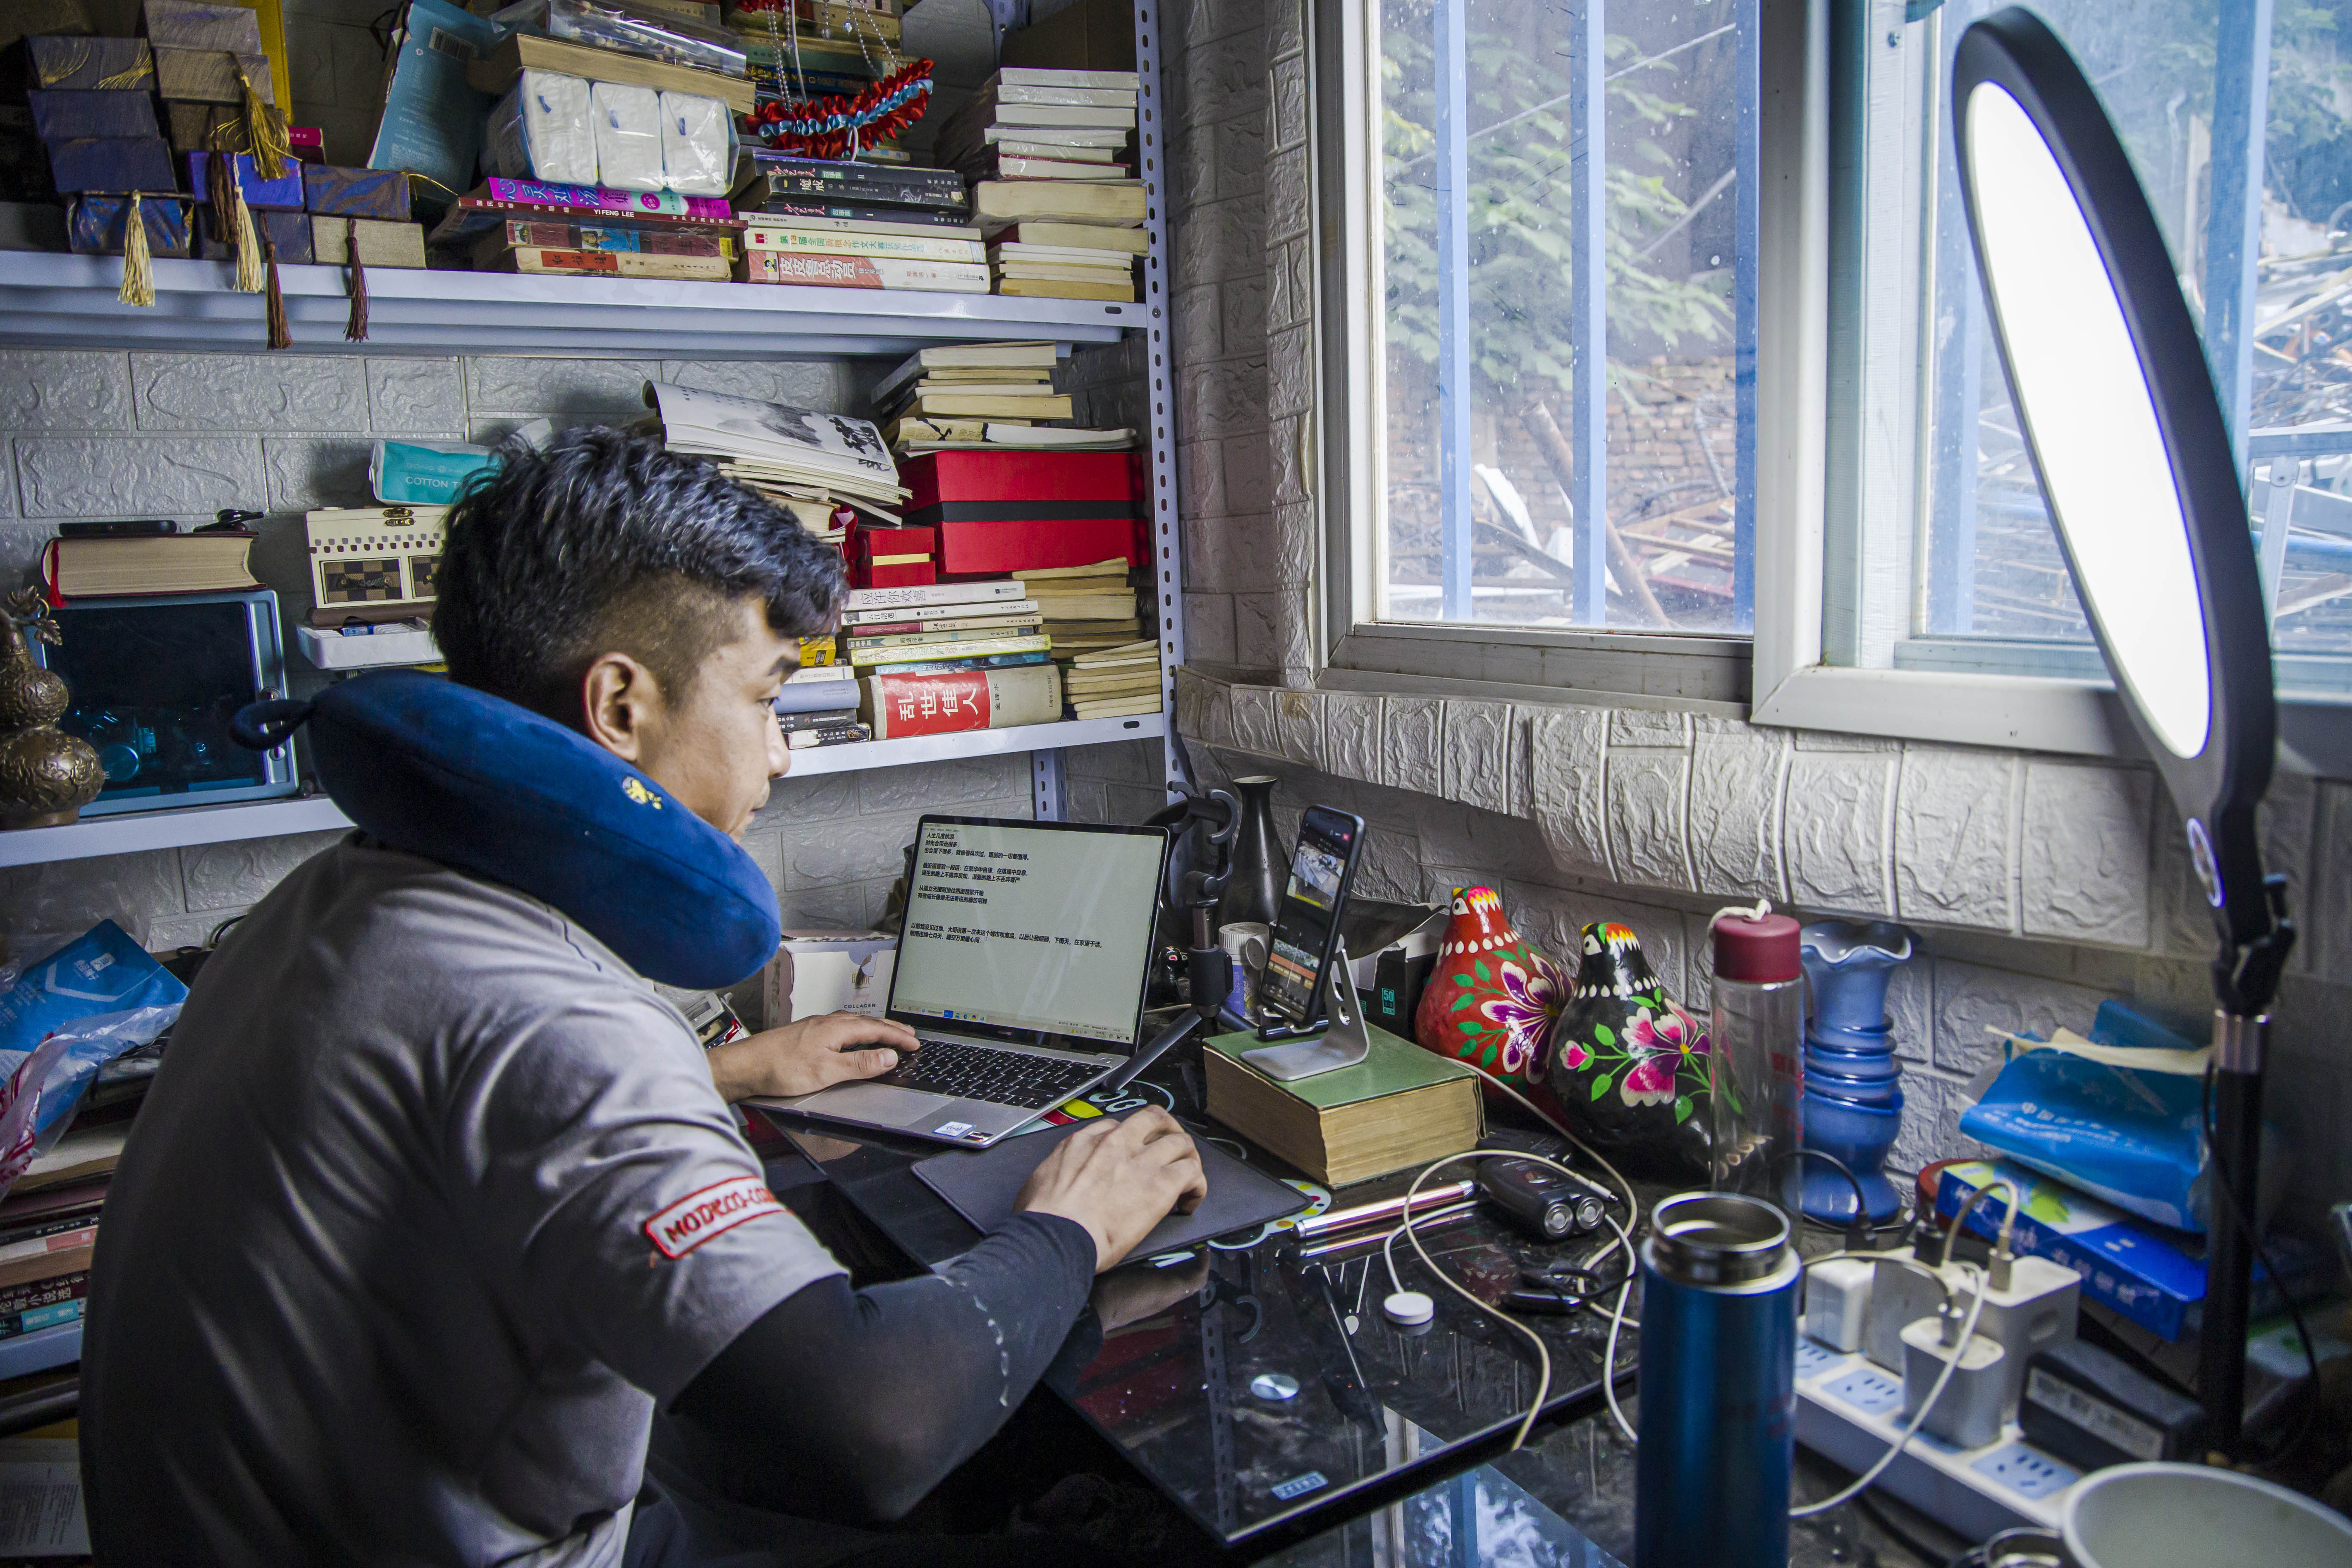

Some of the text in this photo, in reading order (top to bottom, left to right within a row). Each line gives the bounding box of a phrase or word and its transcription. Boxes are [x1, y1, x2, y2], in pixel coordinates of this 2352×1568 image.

[799, 178, 824, 192] 魔戒
[779, 256, 856, 280] 皮皮鲁总动员
[405, 476, 449, 488] COTTON
[860, 589, 926, 607] 应许你欢喜
[866, 609, 895, 621] 云江詩選
[898, 690, 979, 721] 乱世佳人
[919, 884, 984, 897] 从孤立无援到顶住四面楚歌开始
[918, 892, 988, 905] 有些成长像是无法言说的痛苦荆棘
[1383, 989, 1393, 1002] 50
